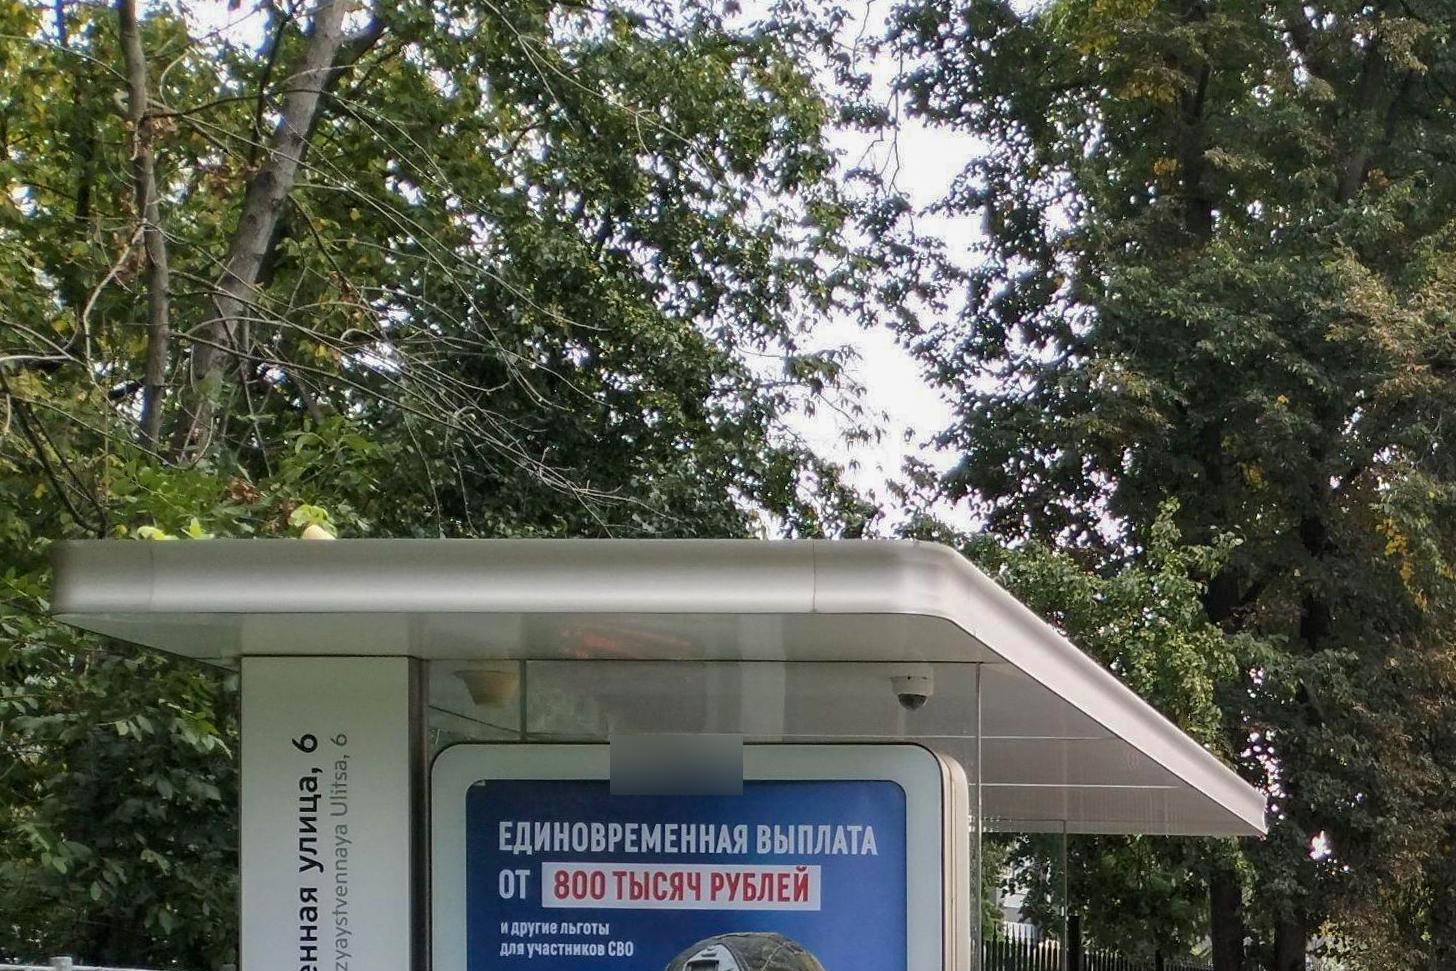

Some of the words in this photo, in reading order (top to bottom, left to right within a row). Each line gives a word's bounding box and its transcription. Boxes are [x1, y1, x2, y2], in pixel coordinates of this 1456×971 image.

[291, 733, 319, 754] 6
[330, 733, 348, 747] 6
[329, 754, 350, 817] Ulitsa,
[299, 763, 323, 873] улица,
[499, 821, 748, 855] ЕДИНОВРЕМЕННАЯ
[757, 824, 878, 856] ВЫПЛАТА
[499, 868, 530, 900] ОТ
[553, 870, 606, 900] 800
[613, 871, 701, 902] ТЫСЯЧ
[710, 865, 810, 903] РУБЛЕЙ
[500, 922, 509, 934] и
[511, 922, 557, 937] другие
[560, 922, 610, 935] льготы
[500, 942, 525, 957] для
[527, 943, 605, 959] участников
[607, 941, 634, 957] СВО
